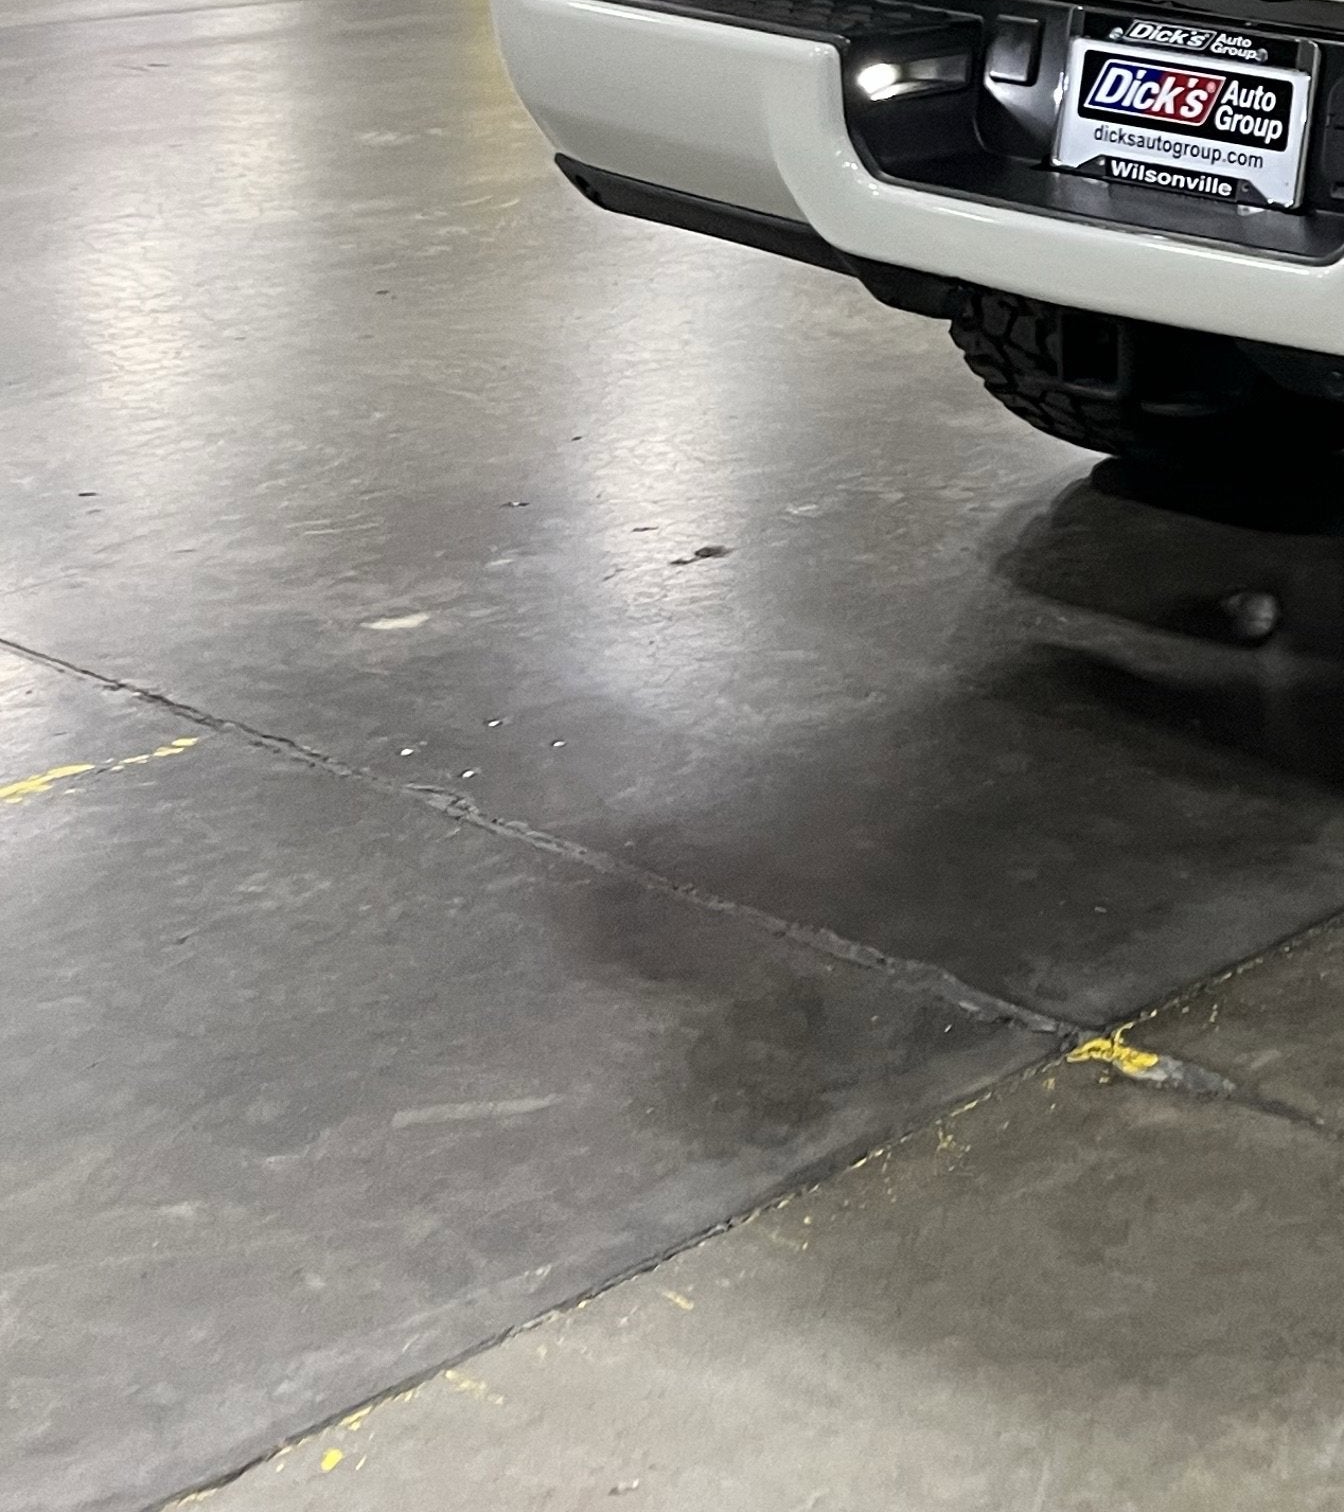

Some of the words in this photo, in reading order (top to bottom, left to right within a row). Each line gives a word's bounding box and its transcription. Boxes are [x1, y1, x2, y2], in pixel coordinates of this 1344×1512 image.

[1129, 23, 1205, 47] Dick's
[1210, 41, 1258, 60] Group
[1216, 33, 1252, 48] Auto
[1095, 66, 1208, 118] Dick's
[1221, 80, 1276, 112] Auto
[1214, 106, 1283, 143] Group
[1094, 124, 1263, 169] dicksautogroup.com
[1111, 159, 1232, 196] Wilsonville
